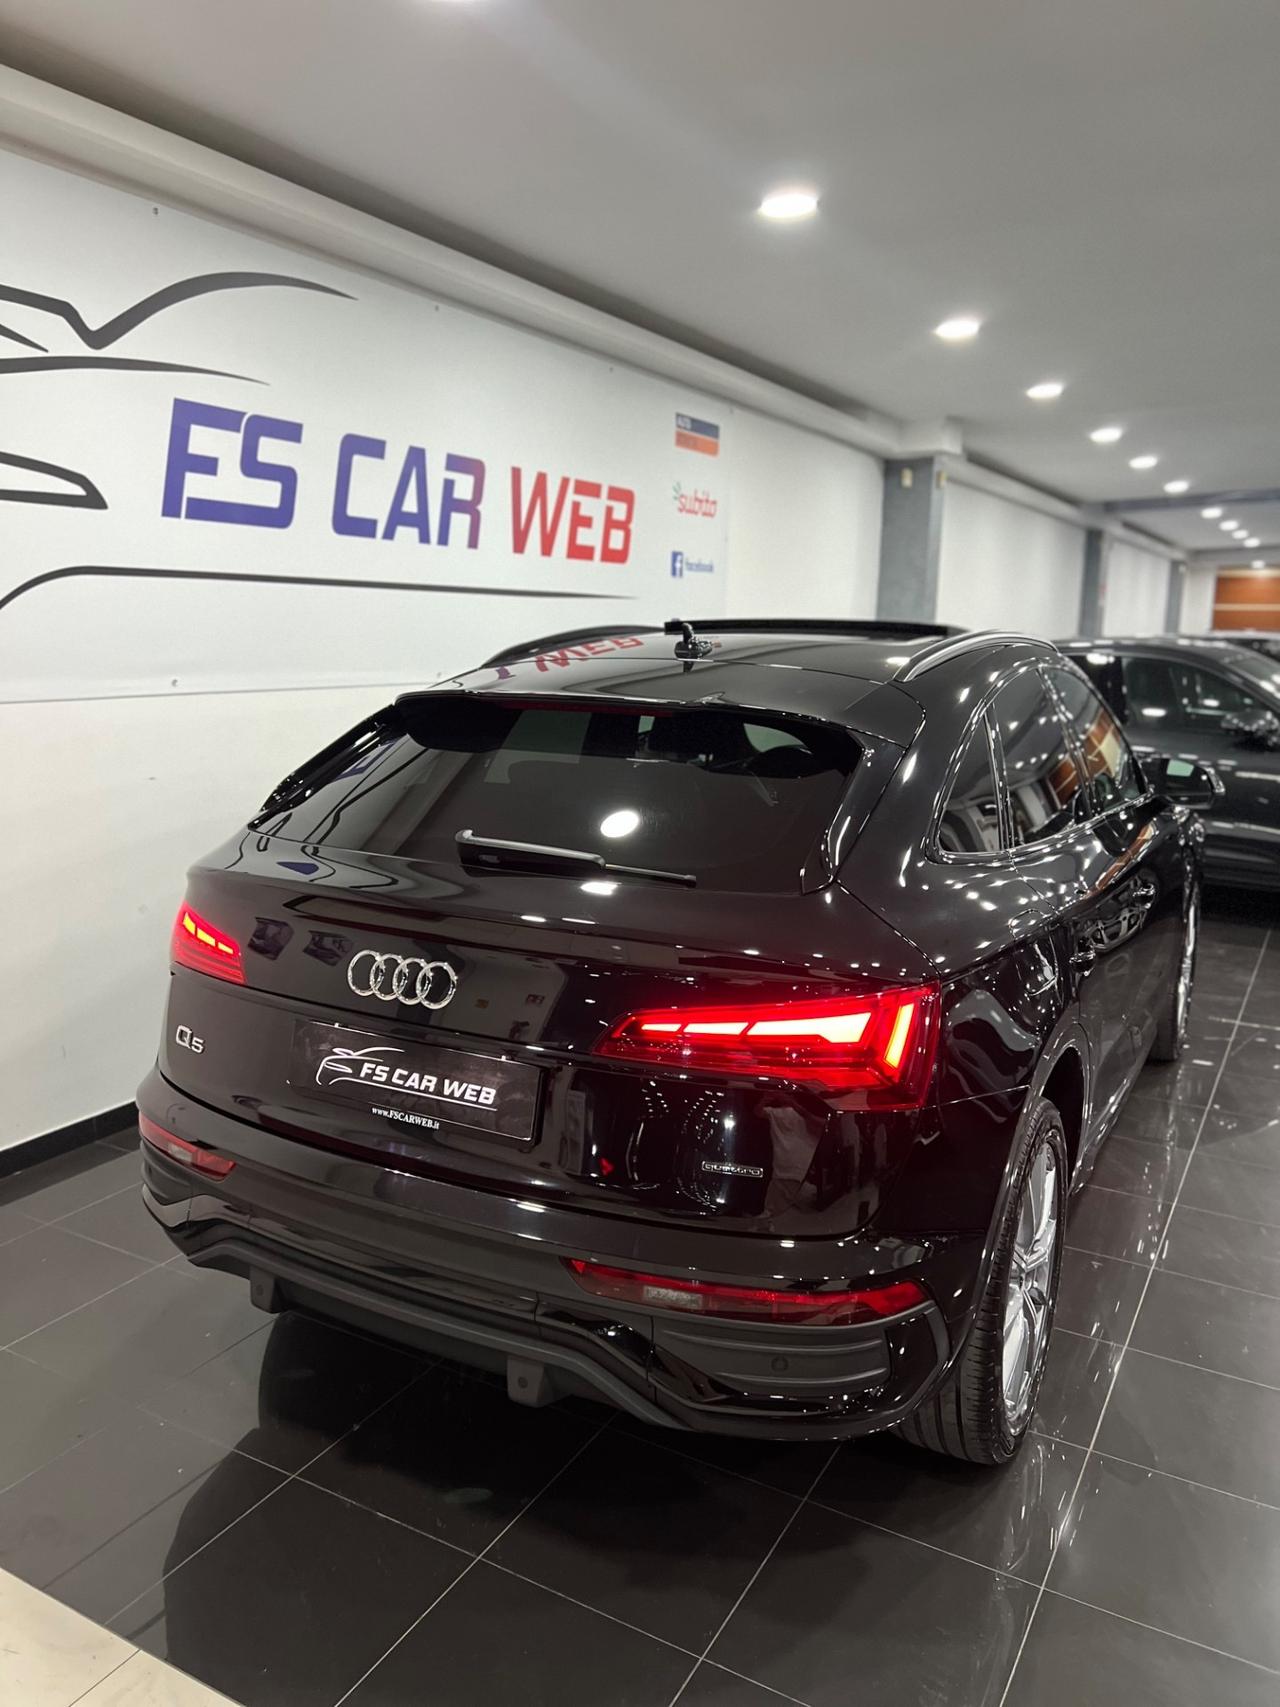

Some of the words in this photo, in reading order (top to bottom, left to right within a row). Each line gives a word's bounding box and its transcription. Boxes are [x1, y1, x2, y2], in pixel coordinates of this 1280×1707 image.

[162, 398, 304, 530] FS
[331, 432, 486, 550] CAR
[510, 466, 636, 565] WEB
[175, 1024, 205, 1054] Q5
[359, 1062, 390, 1082] FS
[391, 1068, 438, 1092] CAR
[443, 1079, 497, 1105] WEB
[371, 1107, 440, 1130] www.FSCARWEB.it
